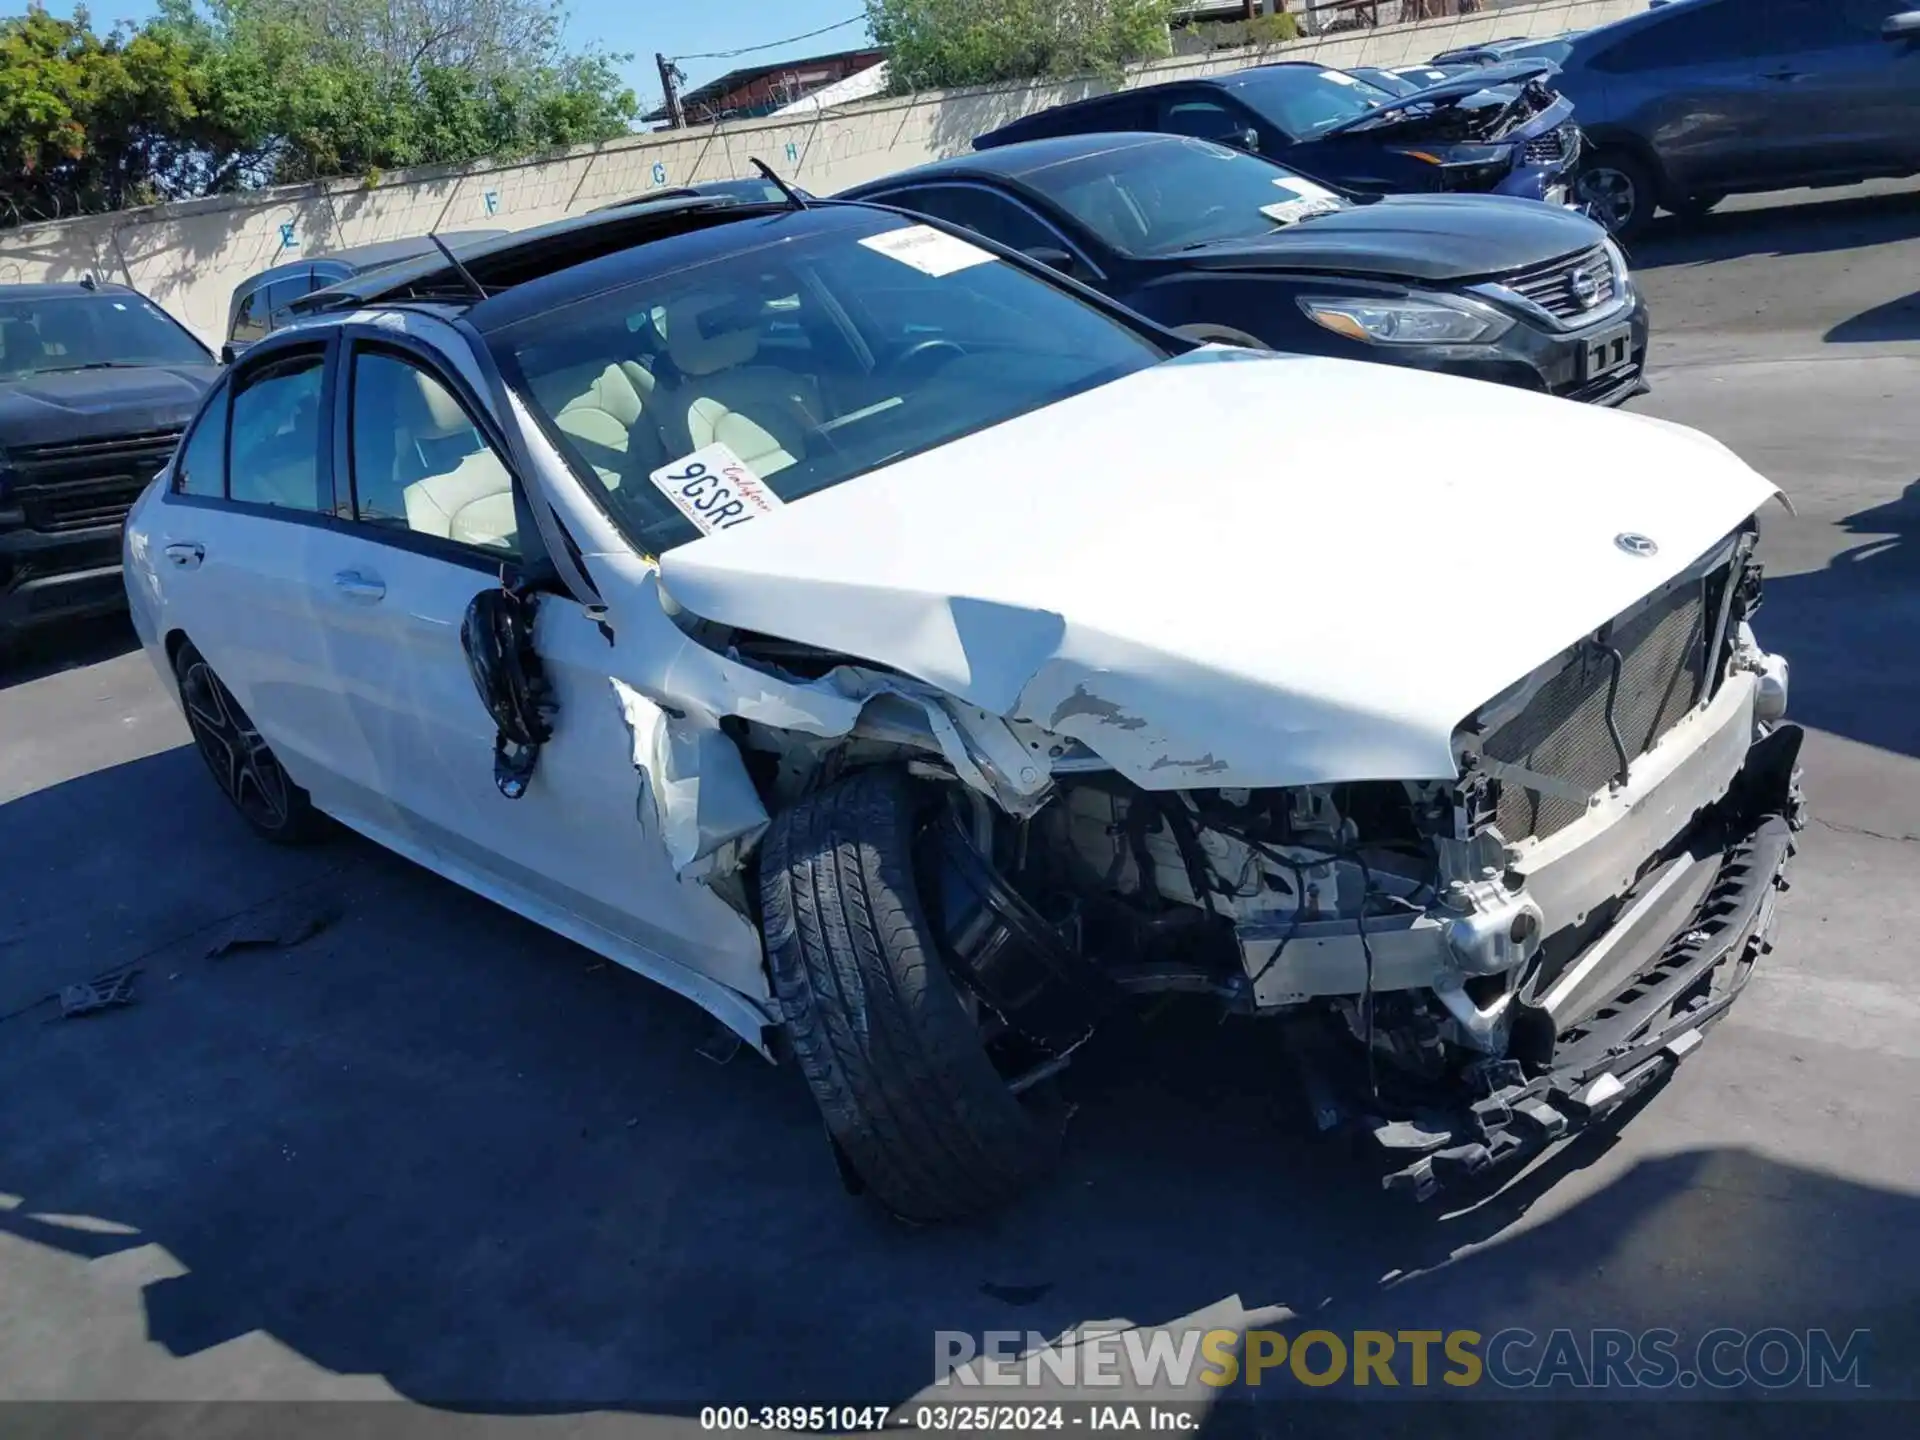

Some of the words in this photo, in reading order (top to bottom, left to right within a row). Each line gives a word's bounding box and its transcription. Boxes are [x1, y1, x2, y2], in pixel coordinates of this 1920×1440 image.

[653, 163, 666, 185] G
[485, 191, 498, 216] F
[279, 223, 300, 248] E
